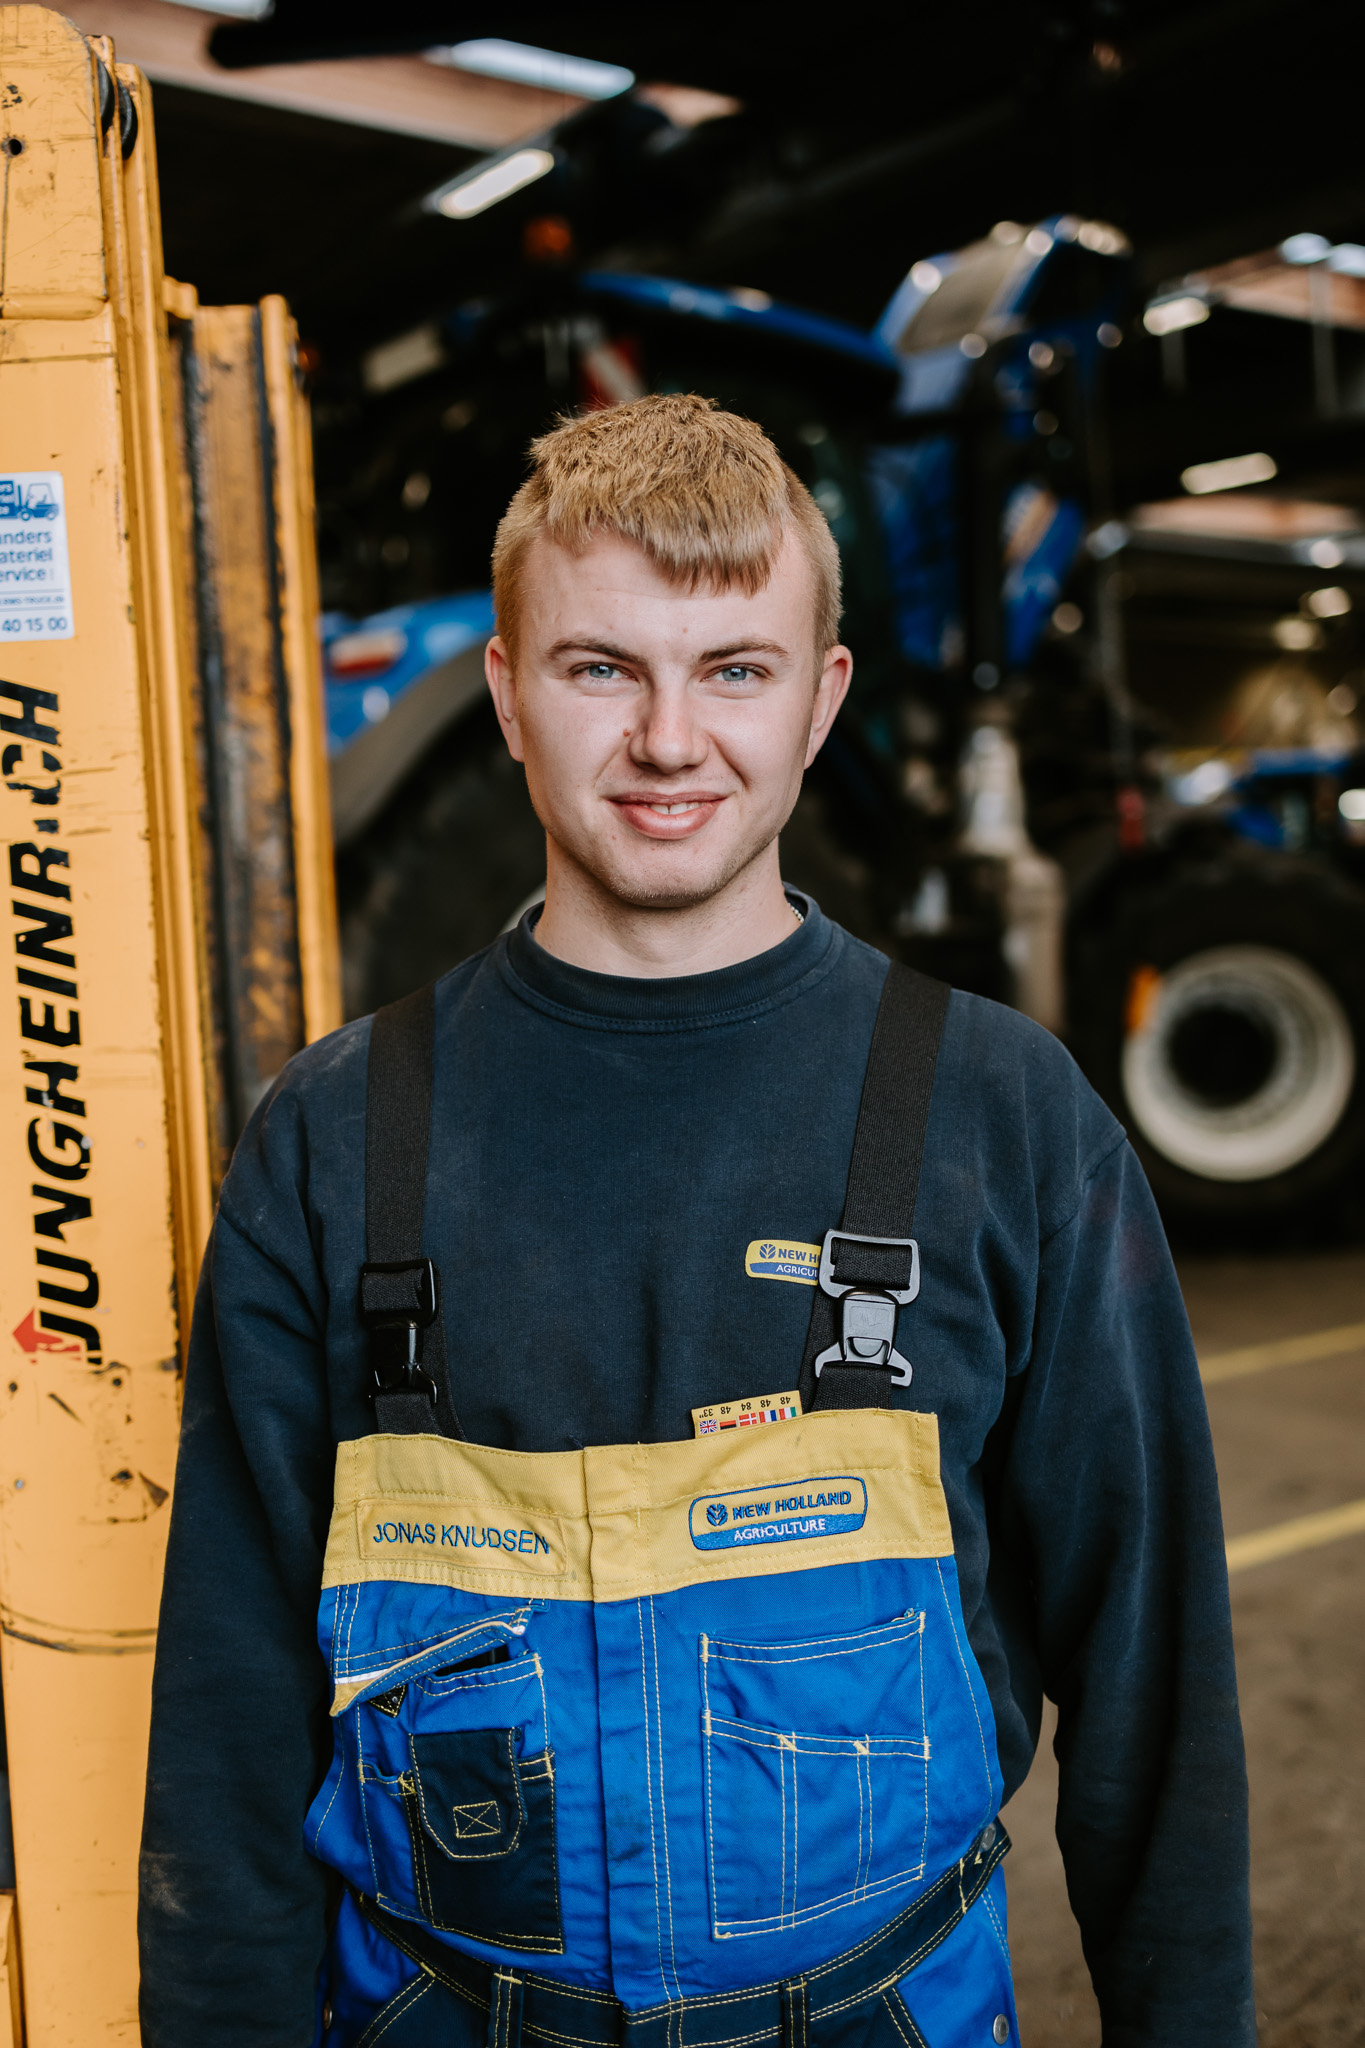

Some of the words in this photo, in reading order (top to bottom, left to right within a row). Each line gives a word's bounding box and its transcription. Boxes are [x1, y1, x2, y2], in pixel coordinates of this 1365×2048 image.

[0, 530, 52, 544] nders
[2, 618, 21, 632] 40
[25, 617, 43, 632] 15
[48, 616, 67, 631] 00
[0, 680, 101, 1364] JUNGHEINRCH
[778, 1248, 807, 1262] NEW
[809, 1251, 820, 1264] H
[740, 1402, 752, 1411] 84
[760, 1399, 771, 1408] 48
[779, 1396, 791, 1405] 48
[719, 1405, 732, 1415] 48
[732, 1501, 771, 1520] NEW
[775, 1490, 852, 1514] HOLLAND
[733, 1518, 827, 1542] AGRICULTURE
[373, 1522, 436, 1544] JONAS
[441, 1524, 550, 1555] KNUDSEN
